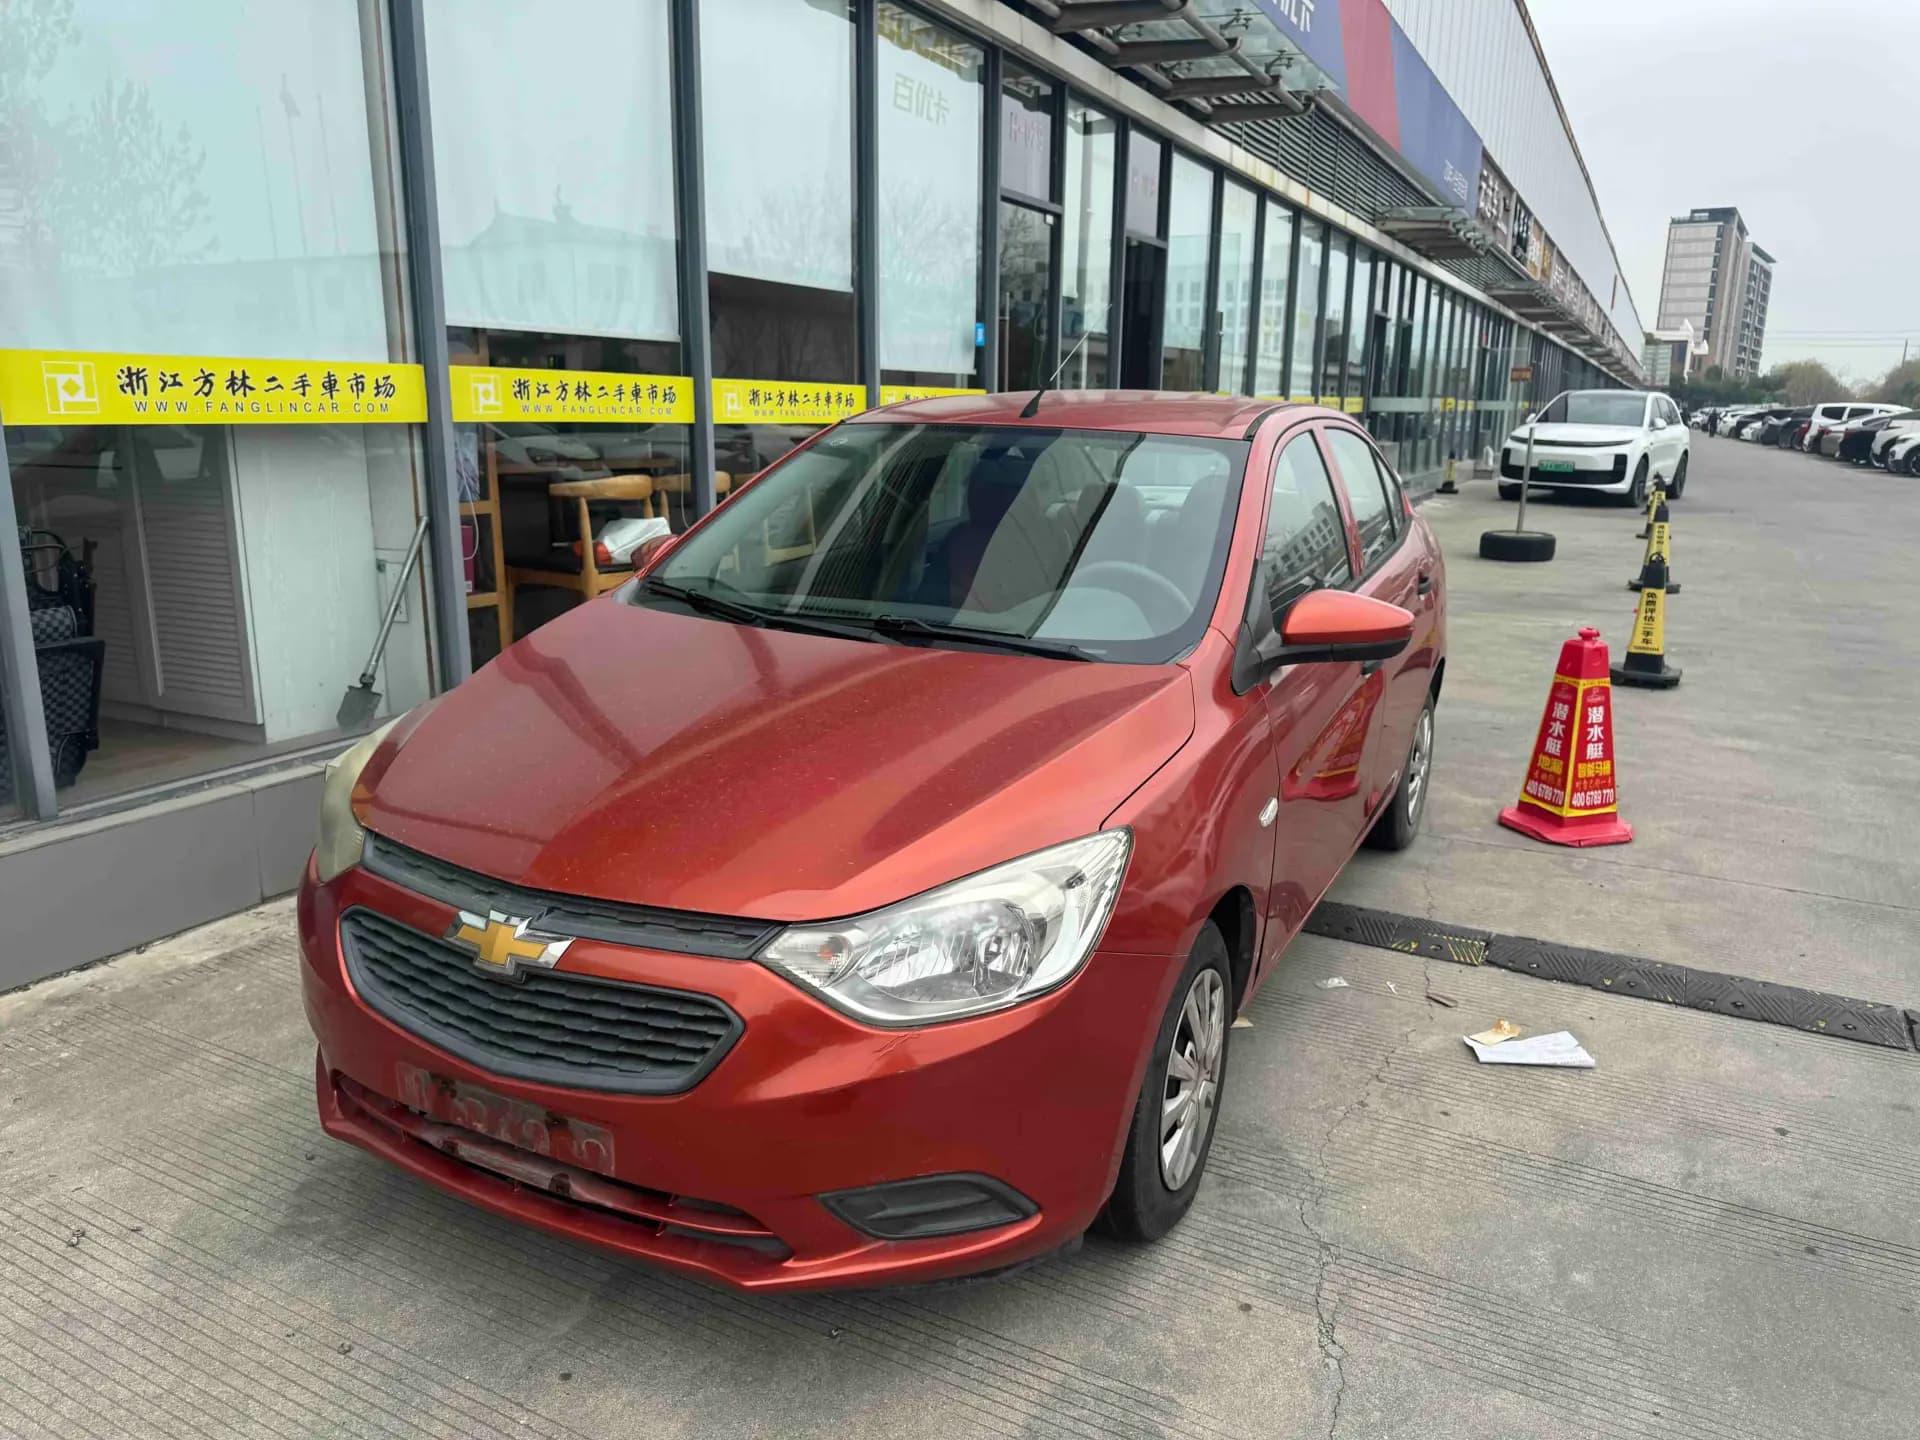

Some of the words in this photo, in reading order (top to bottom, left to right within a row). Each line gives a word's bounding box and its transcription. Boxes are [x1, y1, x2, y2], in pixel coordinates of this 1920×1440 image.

[134, 401, 389, 413] WWW.FANGLINCAR.COM
[1545, 701, 1569, 756] 潜水艇
[1586, 706, 1604, 760] 潜水艇
[1572, 792, 1585, 807] 400
[1603, 788, 1614, 803] 770
